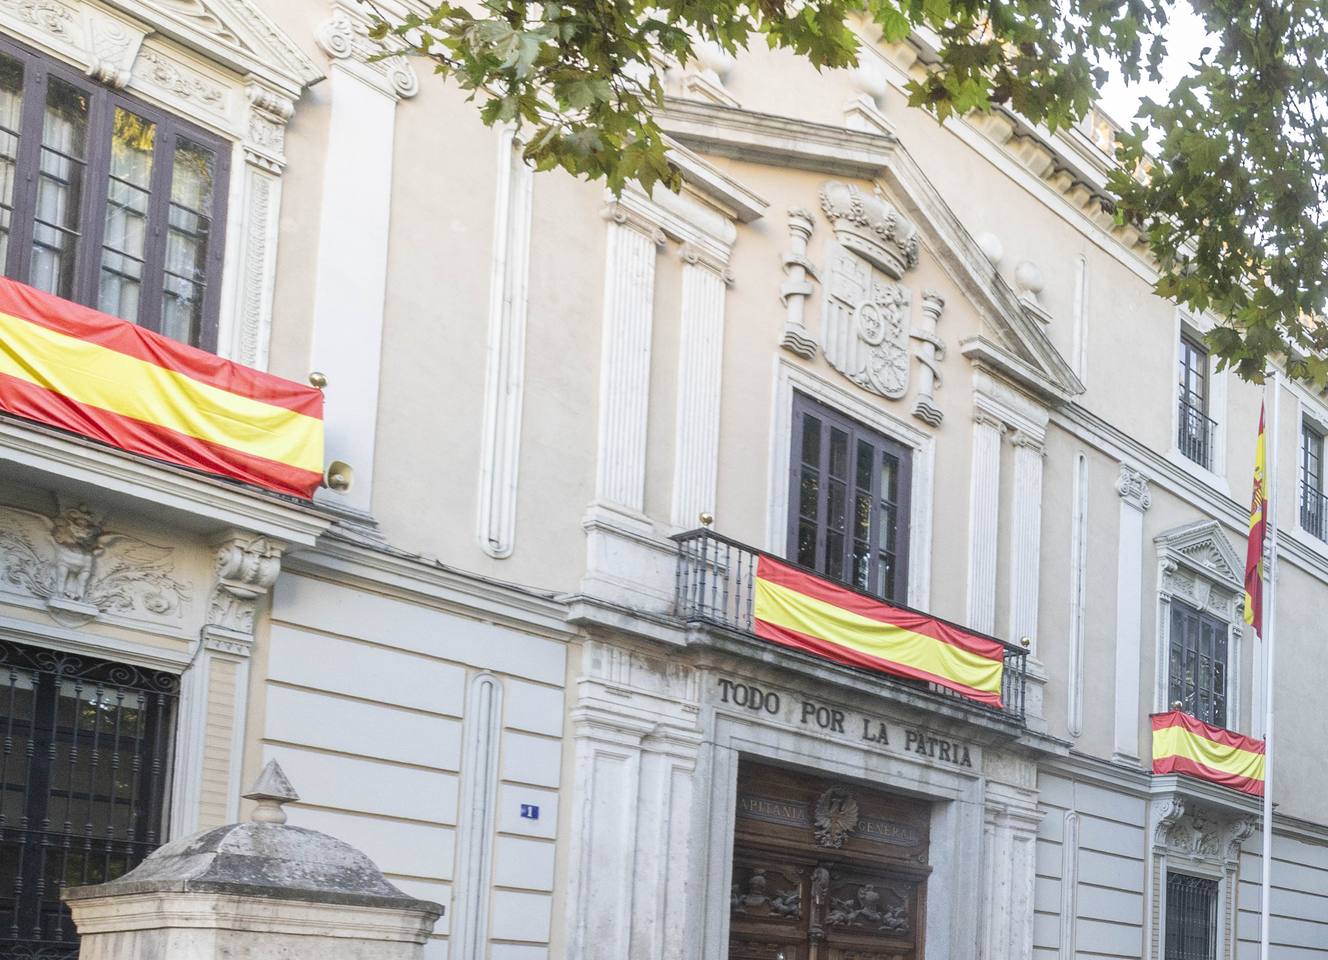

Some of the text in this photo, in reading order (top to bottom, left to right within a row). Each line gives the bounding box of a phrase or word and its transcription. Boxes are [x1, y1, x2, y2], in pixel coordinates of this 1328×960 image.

[718, 678, 973, 768] TODO POR LA PATRIA
[527, 806, 533, 817] 1
